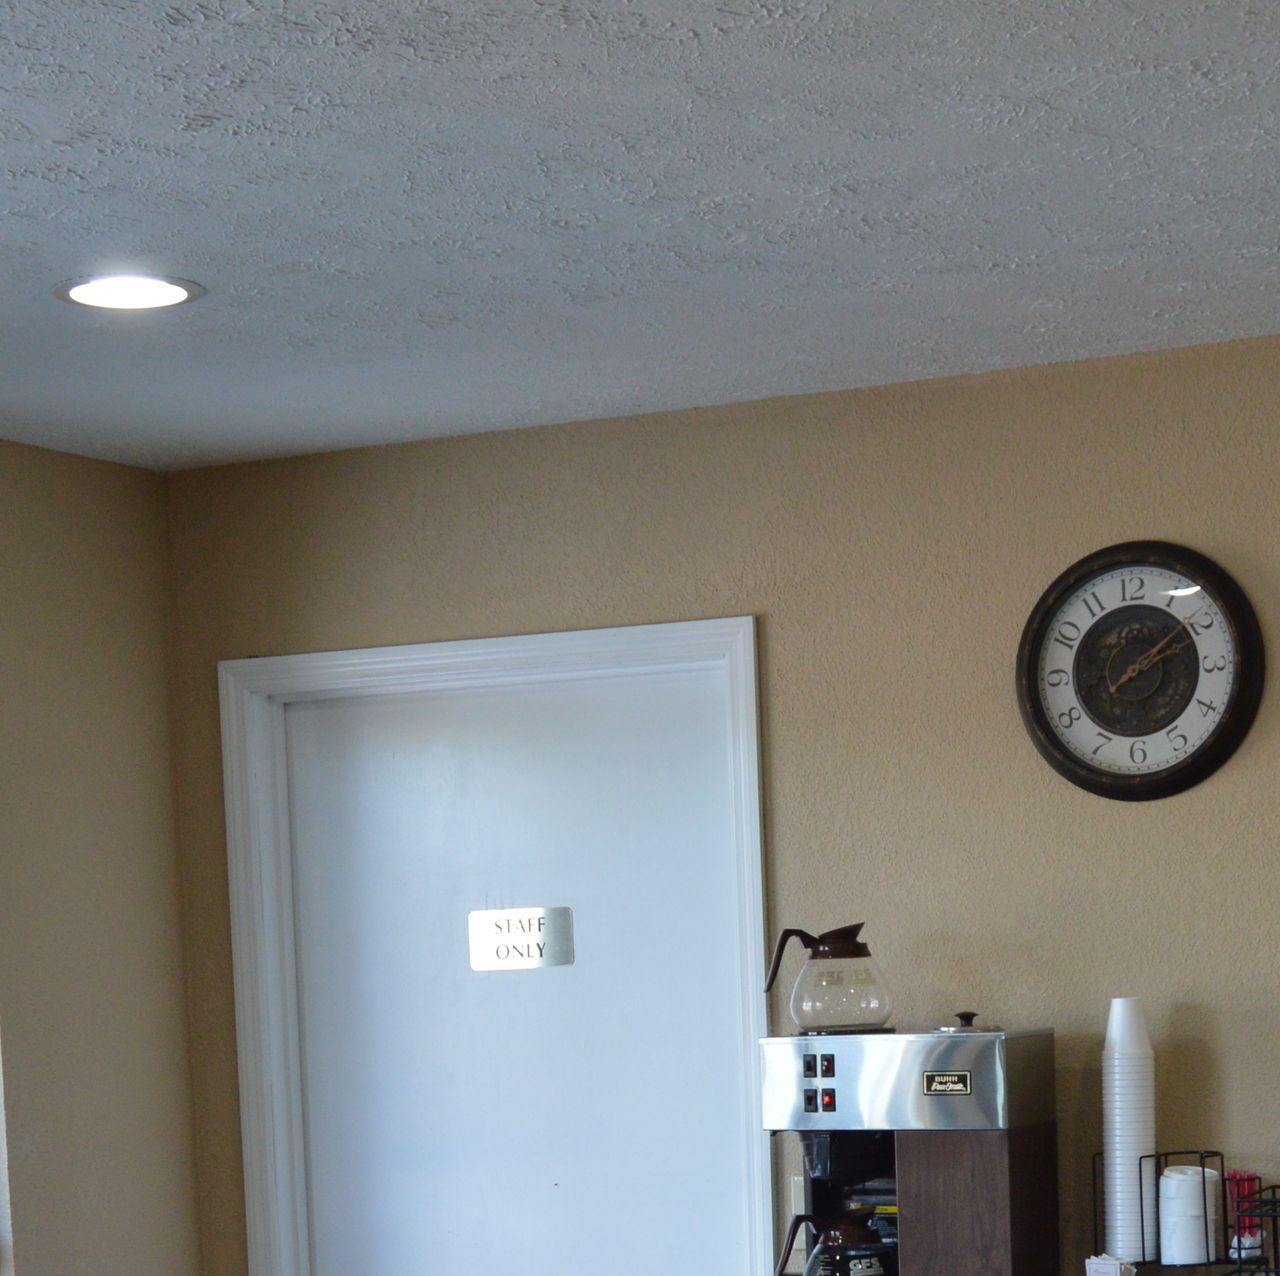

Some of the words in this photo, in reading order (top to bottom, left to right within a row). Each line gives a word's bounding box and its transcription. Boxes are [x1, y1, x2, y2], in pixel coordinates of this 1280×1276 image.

[1120, 577, 1145, 602] 12
[1082, 591, 1106, 619] 11
[1188, 611, 1214, 636] 2
[1054, 621, 1081, 650] 10
[1202, 655, 1226, 674] 3
[1047, 668, 1070, 688] 9
[1058, 706, 1082, 729] 8
[1196, 697, 1218, 718] 4
[1092, 732, 1112, 756] 7
[1166, 724, 1188, 752] 5
[1129, 739, 1148, 765] 6
[494, 916, 547, 935] STAFF
[495, 941, 547, 960] ONLY
[848, 1257, 881, 1270] GFS
